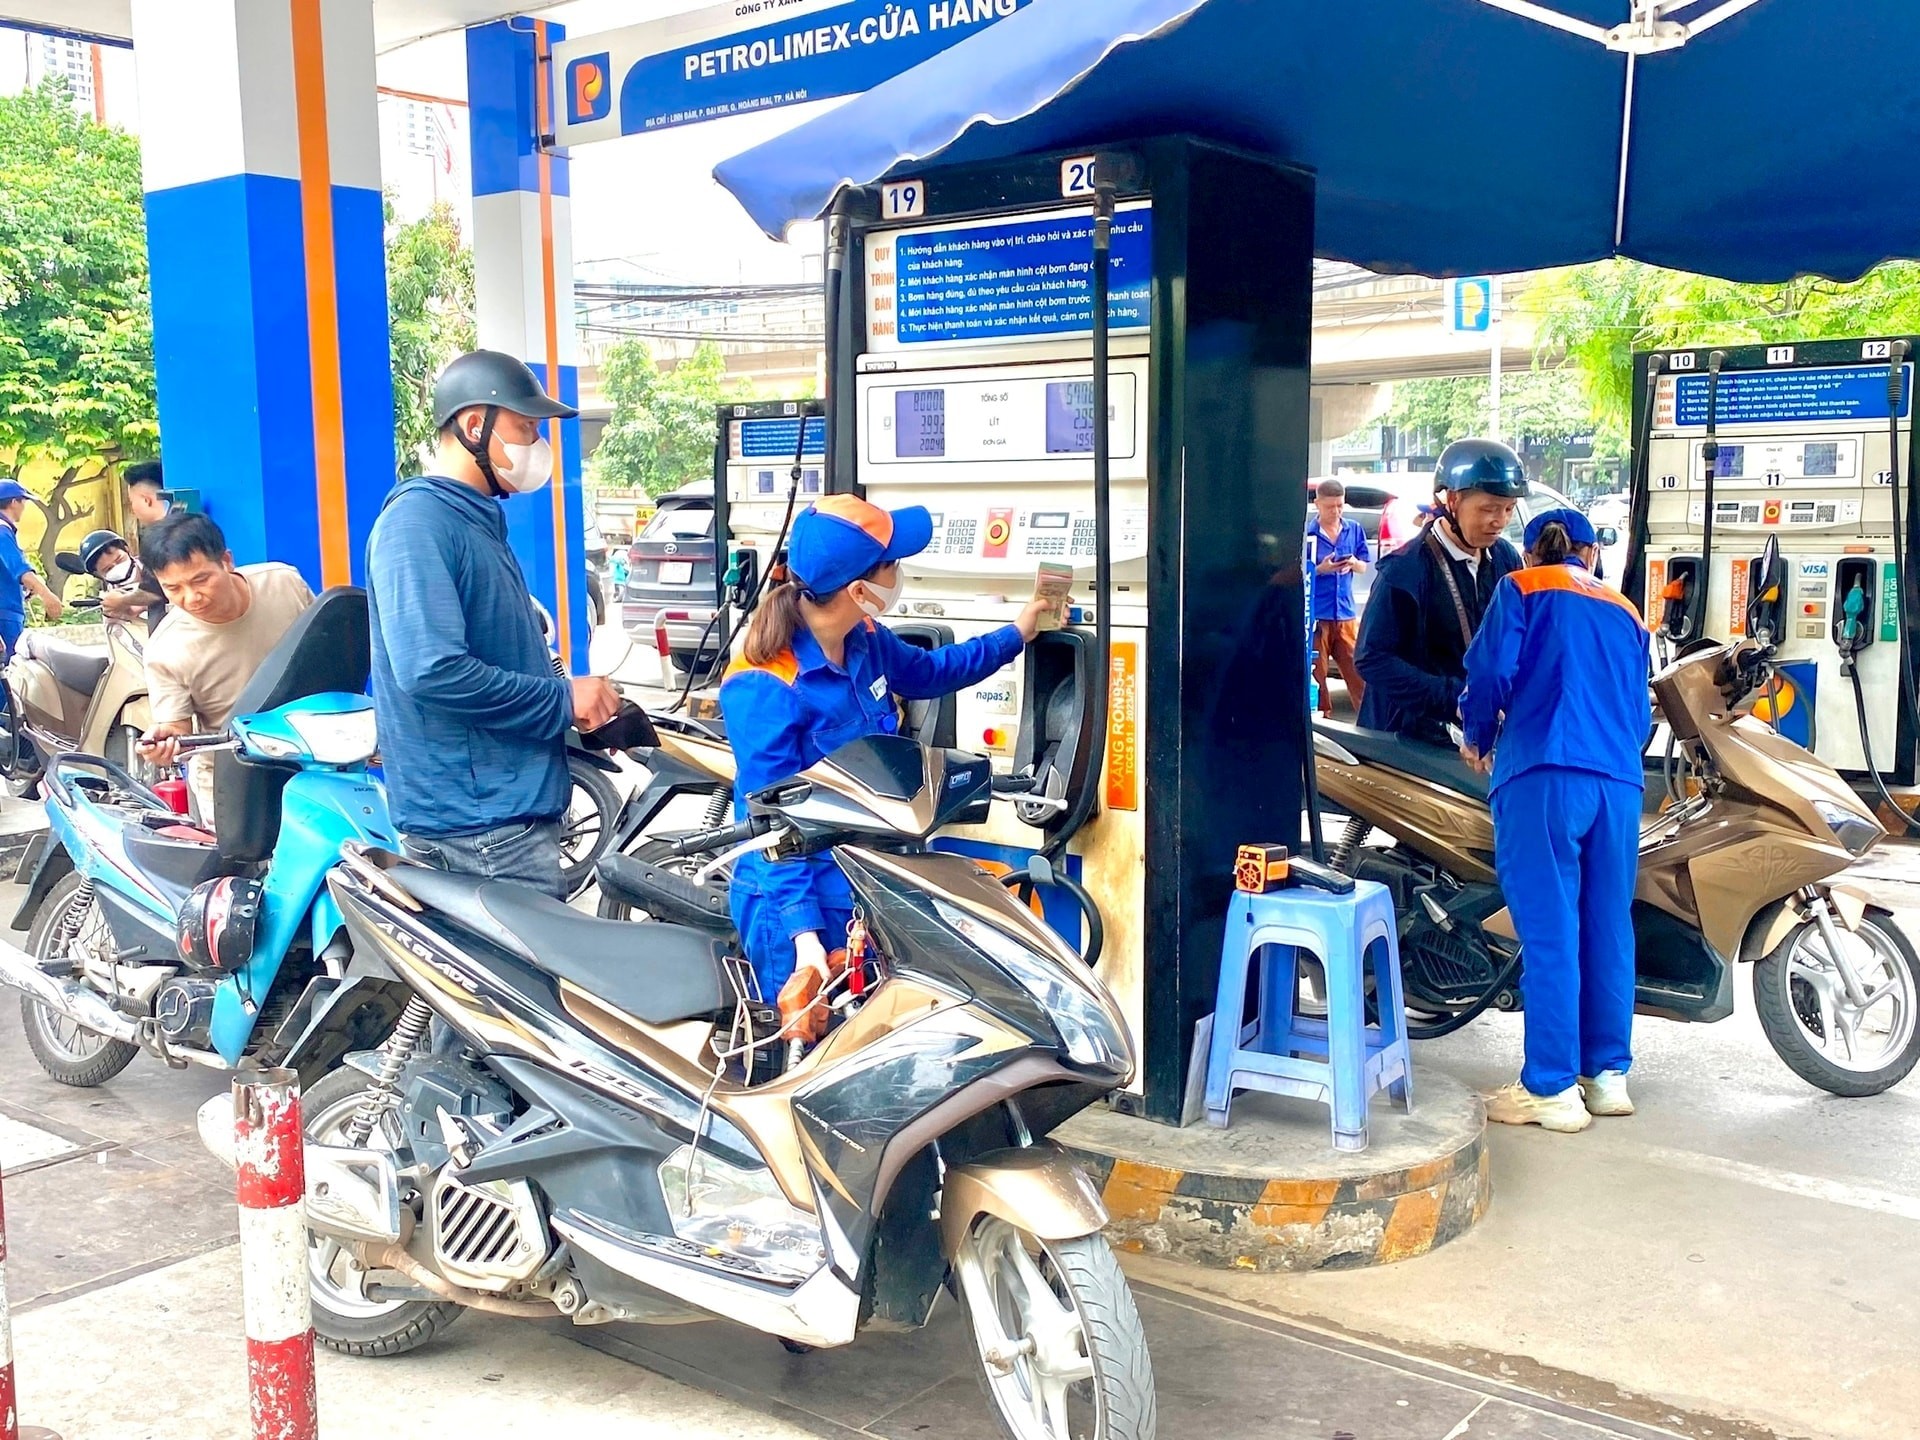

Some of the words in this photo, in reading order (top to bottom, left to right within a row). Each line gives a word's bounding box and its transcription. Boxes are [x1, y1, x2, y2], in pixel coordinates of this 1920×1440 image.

[764, 1, 775, 10] TY
[889, 187, 916, 213] 19
[948, 242, 970, 251] khách
[971, 240, 990, 250] hàng
[991, 238, 1005, 247] vào
[1027, 233, 1046, 244] chào
[1061, 229, 1071, 239] và
[1072, 228, 1086, 238] xác
[1127, 221, 1143, 232] cầu
[875, 247, 890, 261] QUY
[922, 259, 943, 269] khách
[871, 269, 895, 286] TRÌNH
[922, 275, 944, 286] khách
[945, 274, 963, 284] hàng
[964, 272, 978, 281] xác
[979, 270, 997, 281] nhận
[999, 267, 1015, 277] màn
[1016, 265, 1034, 277] hình
[1034, 265, 1047, 277] cột
[1048, 263, 1067, 274] bơm
[1068, 262, 1088, 273] đang
[907, 293, 925, 302] Bơm
[926, 291, 944, 301] hàng
[978, 286, 994, 295] theo
[1041, 280, 1065, 291] khách
[874, 294, 892, 311] BÁN
[923, 306, 944, 316] khách
[945, 304, 964, 315] hàng
[965, 303, 978, 313] xác
[979, 301, 997, 312] nhận
[999, 299, 1015, 310] màn
[1016, 298, 1033, 309] hình
[1034, 297, 1047, 309] cột
[1048, 295, 1067, 306] bơm
[1068, 295, 1091, 305] trước
[872, 320, 895, 336] HÀNG
[944, 320, 965, 330] thanh
[966, 318, 982, 328] toán
[993, 316, 1008, 326] xác
[1008, 314, 1028, 326] nhận
[1772, 350, 1789, 360] 11
[1867, 345, 1885, 356] 12
[1674, 356, 1691, 367] 10
[989, 416, 1000, 427] LÍT
[1661, 476, 1675, 488] 10
[1766, 474, 1780, 485] 11
[1878, 472, 1893, 484] 12
[1802, 565, 1828, 574] VISA
[976, 691, 1003, 702] napas
[1110, 740, 1125, 790] XĂNG
